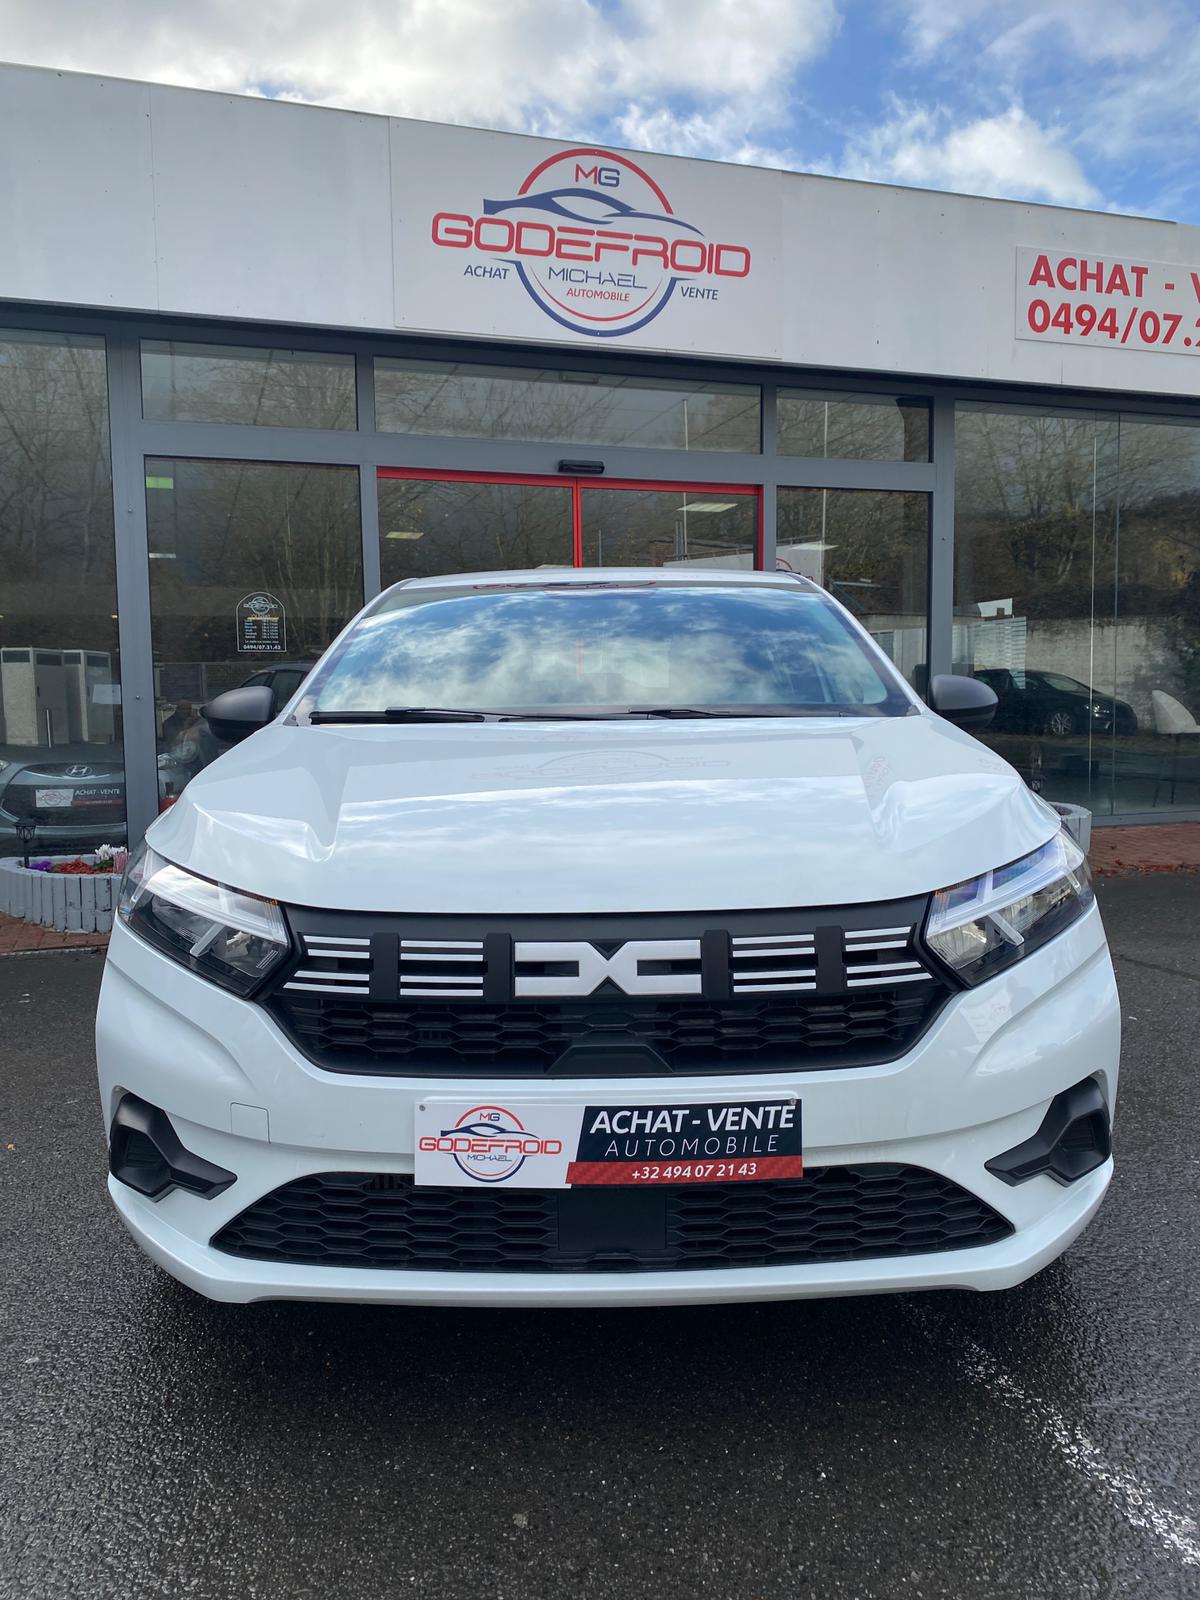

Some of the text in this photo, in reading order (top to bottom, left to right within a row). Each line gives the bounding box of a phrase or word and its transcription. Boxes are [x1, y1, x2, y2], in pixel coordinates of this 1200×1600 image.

[575, 163, 621, 188] MG
[431, 211, 751, 278] GODEFROID
[463, 264, 510, 281] ACHAT
[548, 266, 648, 290] MICHAEL
[1028, 254, 1149, 298] ACHAT
[566, 287, 631, 303] AUTOMOBILE
[680, 286, 719, 301] VENTE
[1027, 298, 1200, 348] 0494/07.
[479, 1111, 500, 1122] MG
[590, 1109, 684, 1135] ACHAT
[706, 1105, 796, 1132] VENTE
[418, 1136, 563, 1155] GODEFROID
[605, 1134, 780, 1158] AUTOMOBILE
[466, 1153, 513, 1162] MICHAEL
[631, 1162, 757, 1180] +32 494 07 21 43
